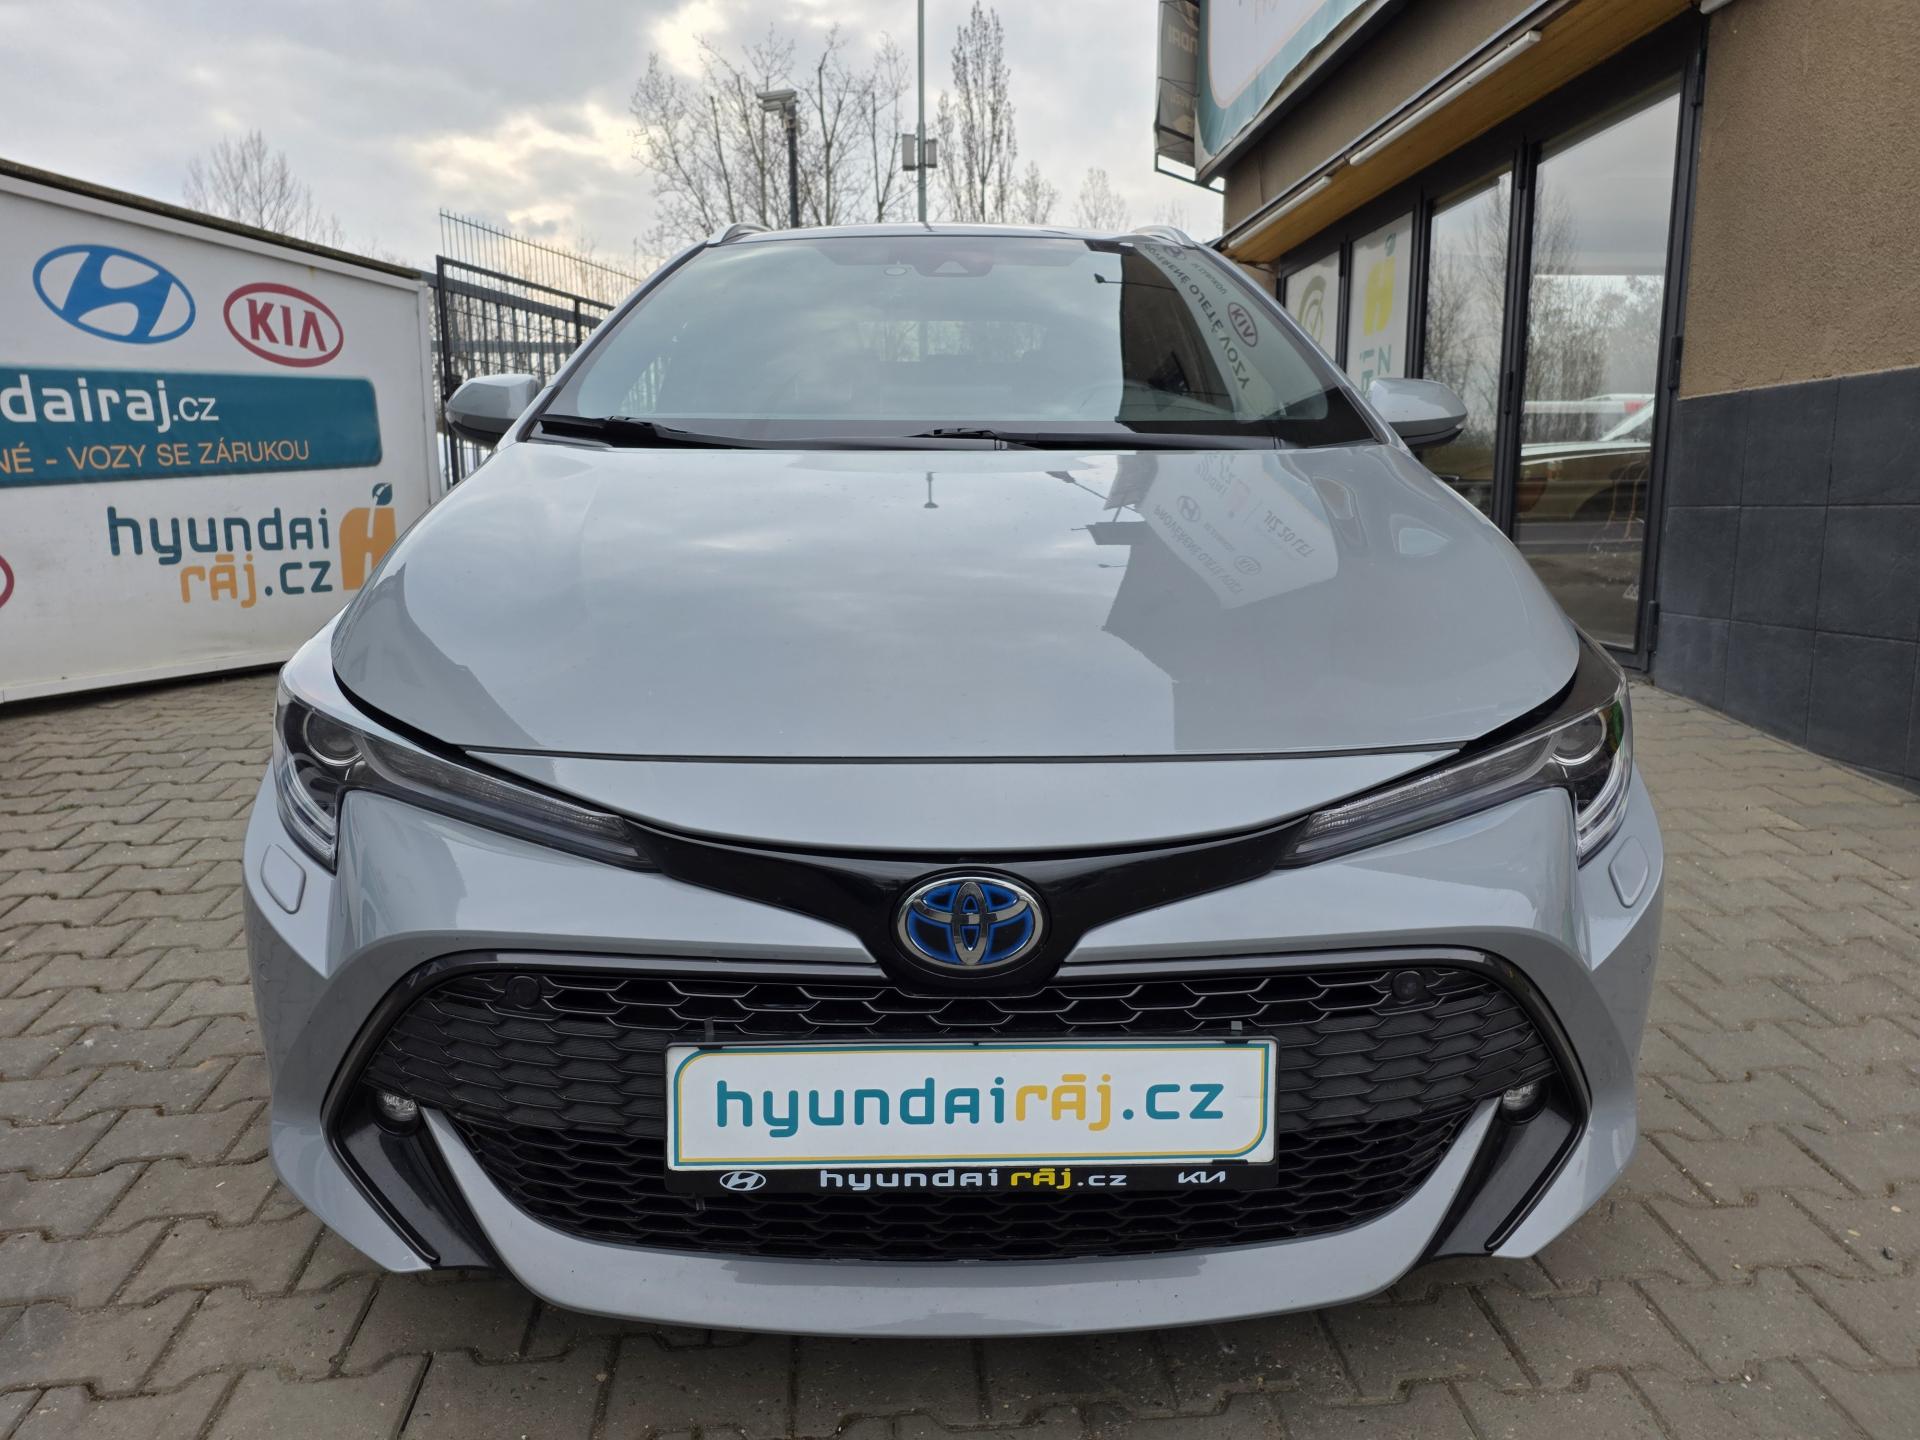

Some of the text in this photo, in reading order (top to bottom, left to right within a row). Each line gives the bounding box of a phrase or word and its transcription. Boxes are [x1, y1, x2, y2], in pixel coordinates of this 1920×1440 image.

[246, 298, 328, 352] KIA
[0, 373, 219, 434] dairaj.cz
[66, 444, 147, 471] VOZY
[156, 443, 192, 467] SE
[198, 436, 310, 465] ZÁRUKOU
[107, 506, 330, 565] hyundai
